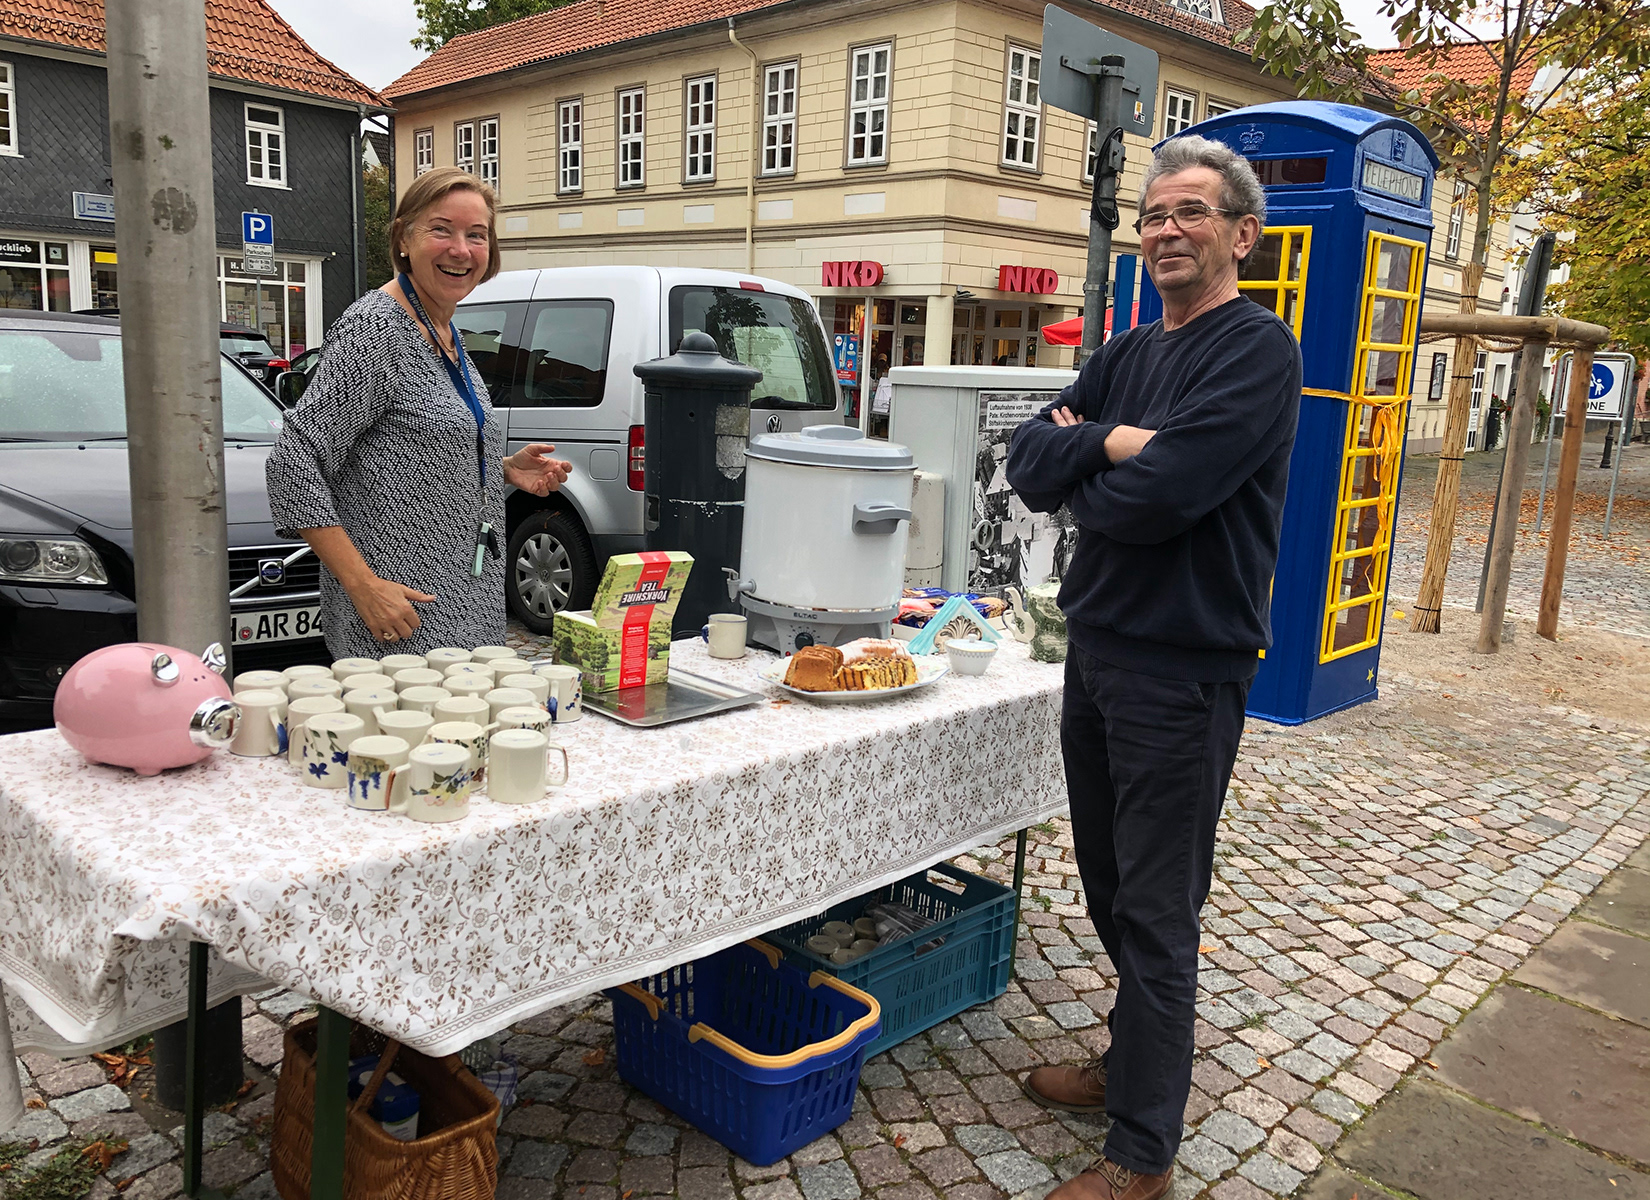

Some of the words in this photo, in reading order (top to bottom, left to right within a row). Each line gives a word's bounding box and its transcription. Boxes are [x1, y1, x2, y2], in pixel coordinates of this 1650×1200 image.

[1365, 163, 1421, 200] TELEPHONE
[250, 217, 266, 240] P
[822, 261, 884, 287] NKD
[998, 265, 1059, 294] NKD
[621, 590, 668, 604] YORKSHIRE
[641, 581, 657, 592] TEA
[256, 613, 289, 640] AR
